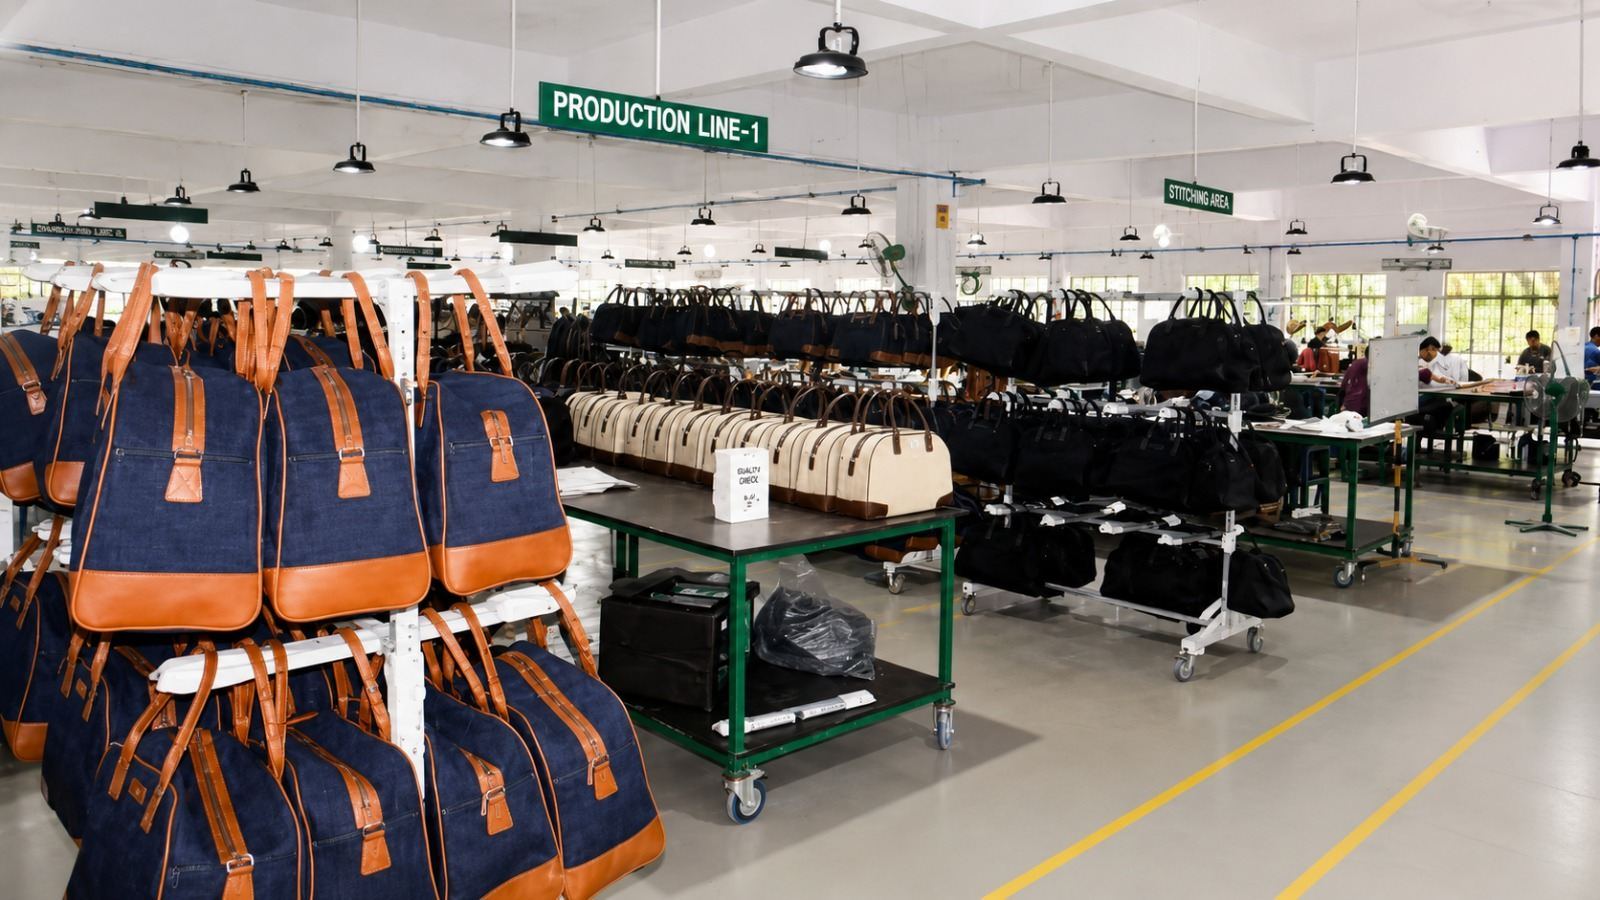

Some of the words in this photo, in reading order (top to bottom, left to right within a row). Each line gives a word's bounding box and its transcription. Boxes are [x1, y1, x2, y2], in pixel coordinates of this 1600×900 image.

[553, 90, 690, 134] PRODUCTION
[698, 112, 759, 144] LINE-1
[1169, 184, 1209, 206] STITCHING
[1210, 193, 1230, 209] AREA
